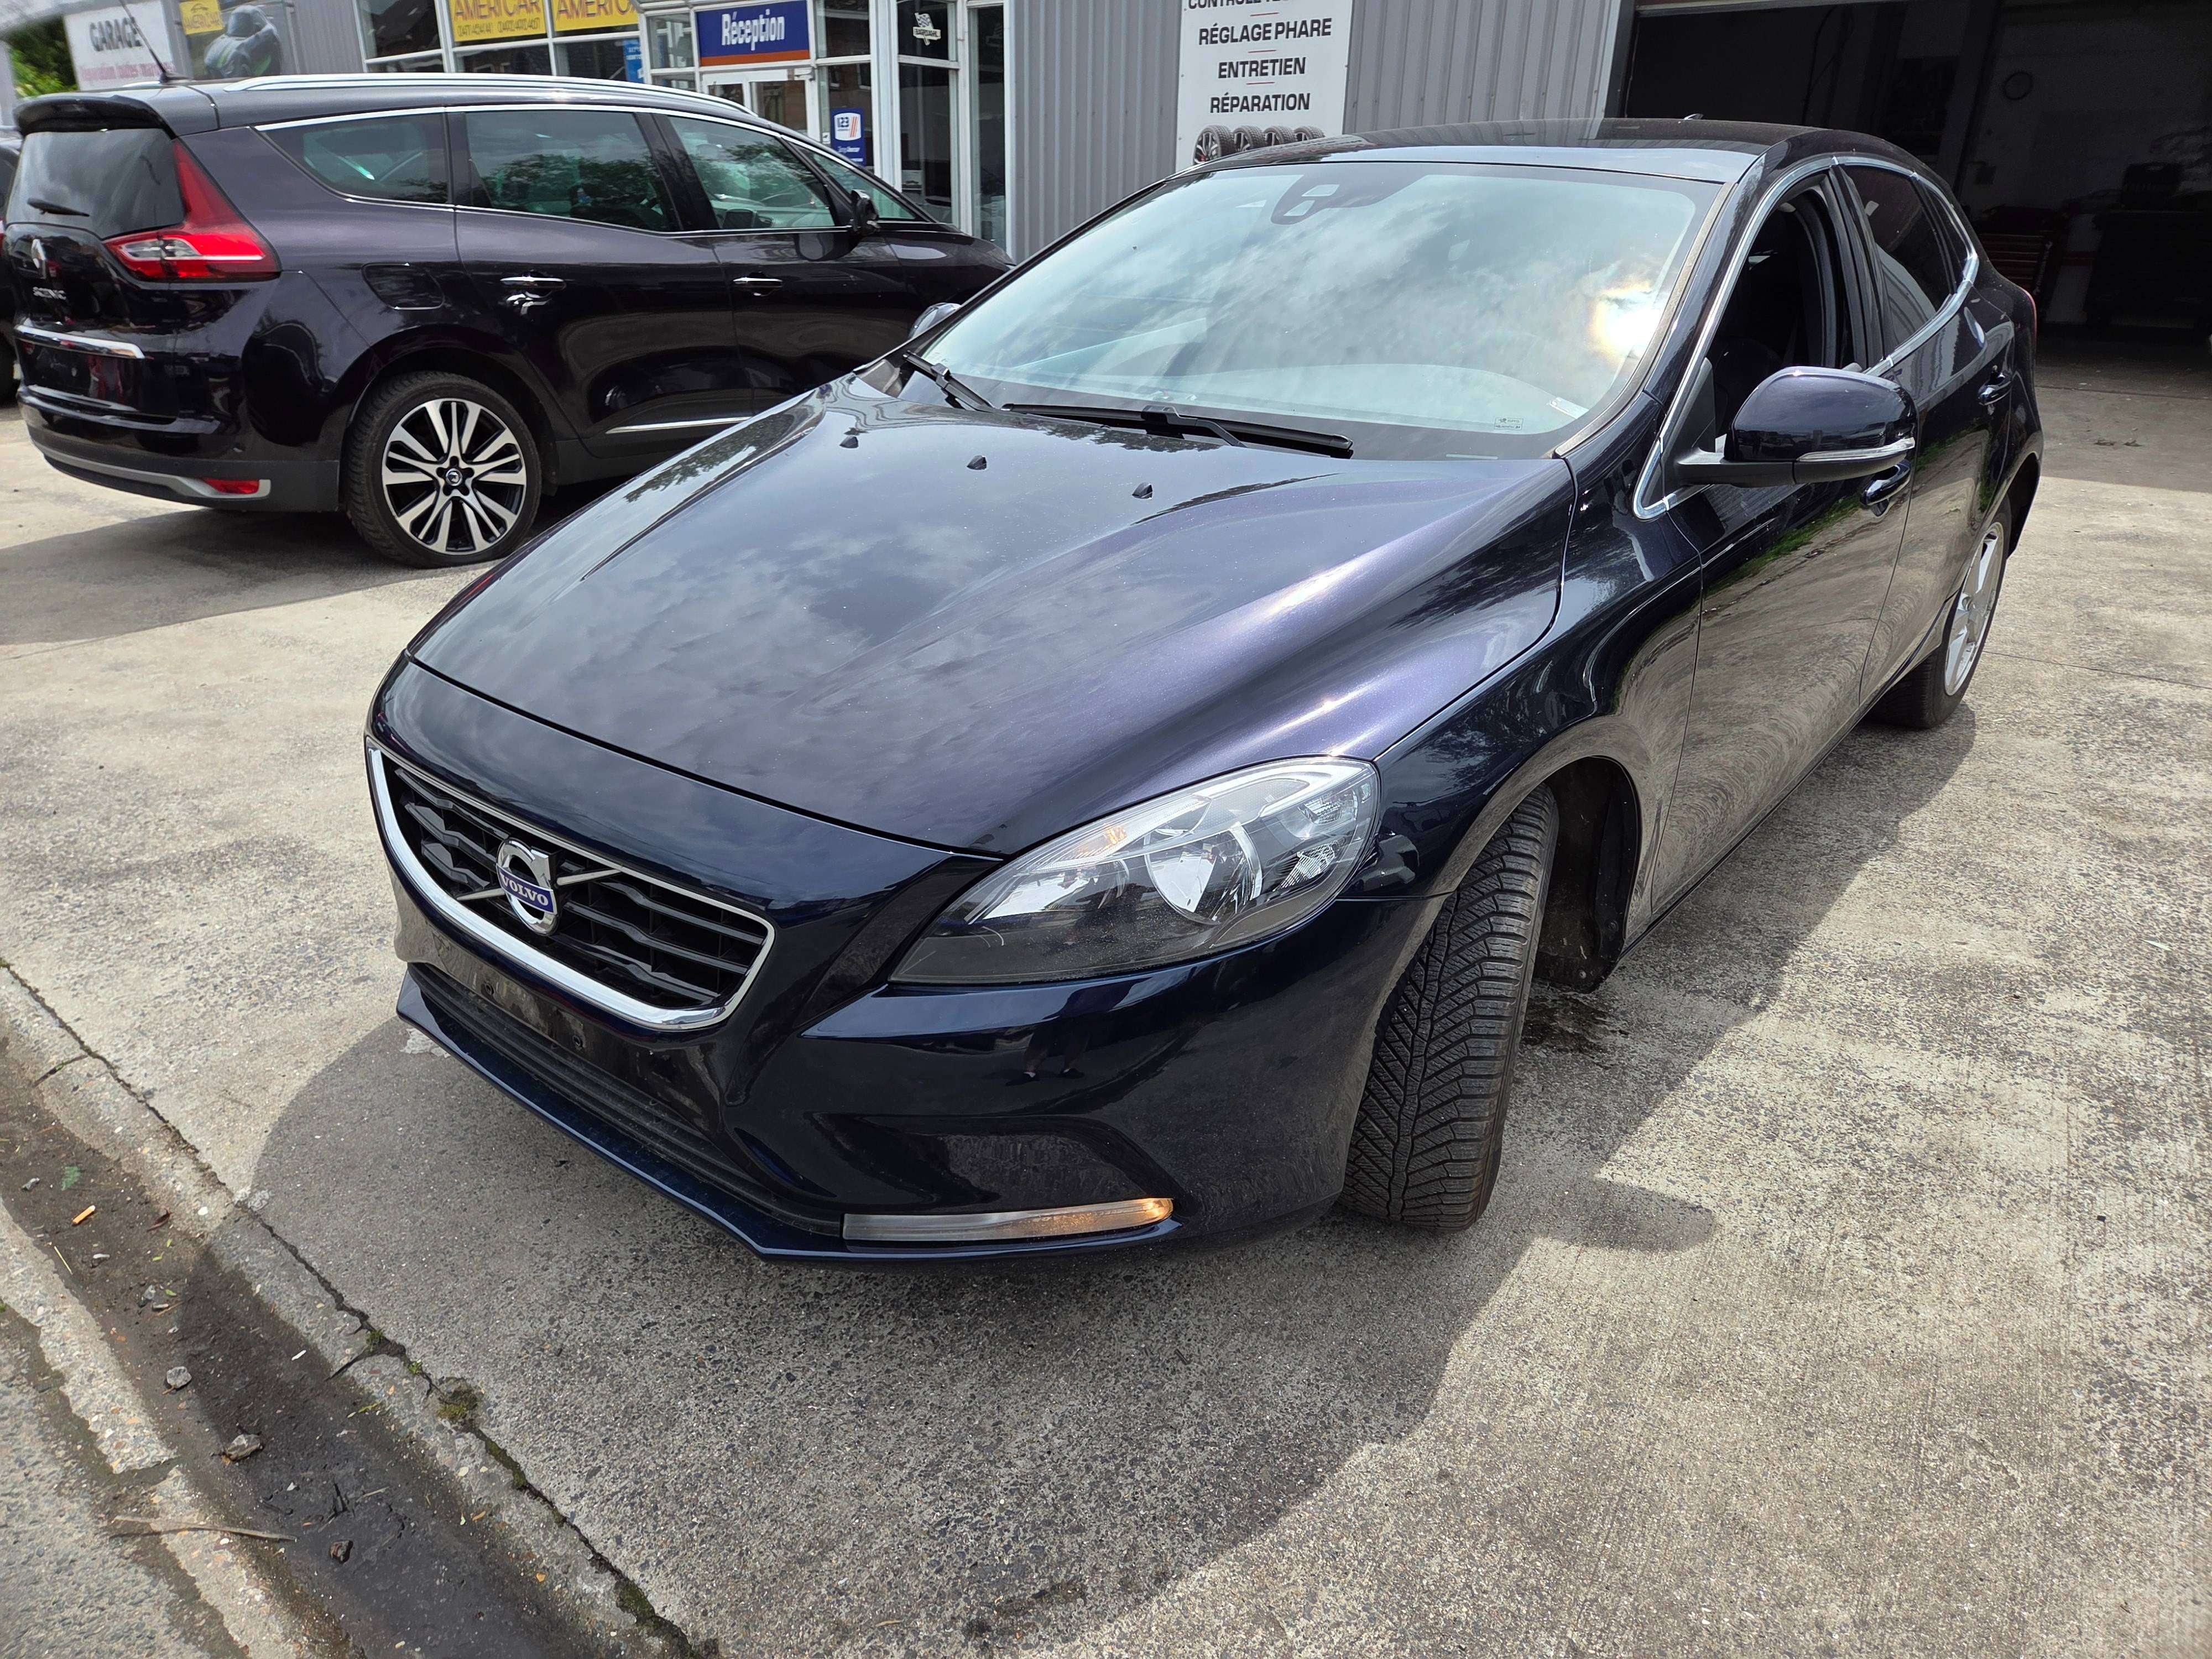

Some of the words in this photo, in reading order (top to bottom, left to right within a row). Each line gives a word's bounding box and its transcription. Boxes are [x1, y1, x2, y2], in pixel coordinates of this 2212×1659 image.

[90, 16, 143, 51] GARAGE
[722, 8, 785, 51] Réception
[1199, 23, 1272, 45] RÉGLAGE
[1274, 18, 1332, 39] PHARE
[1218, 56, 1306, 79] ENTRETIEN
[1210, 92, 1311, 113] RÉPARATION
[499, 872, 549, 906] VOLVO
